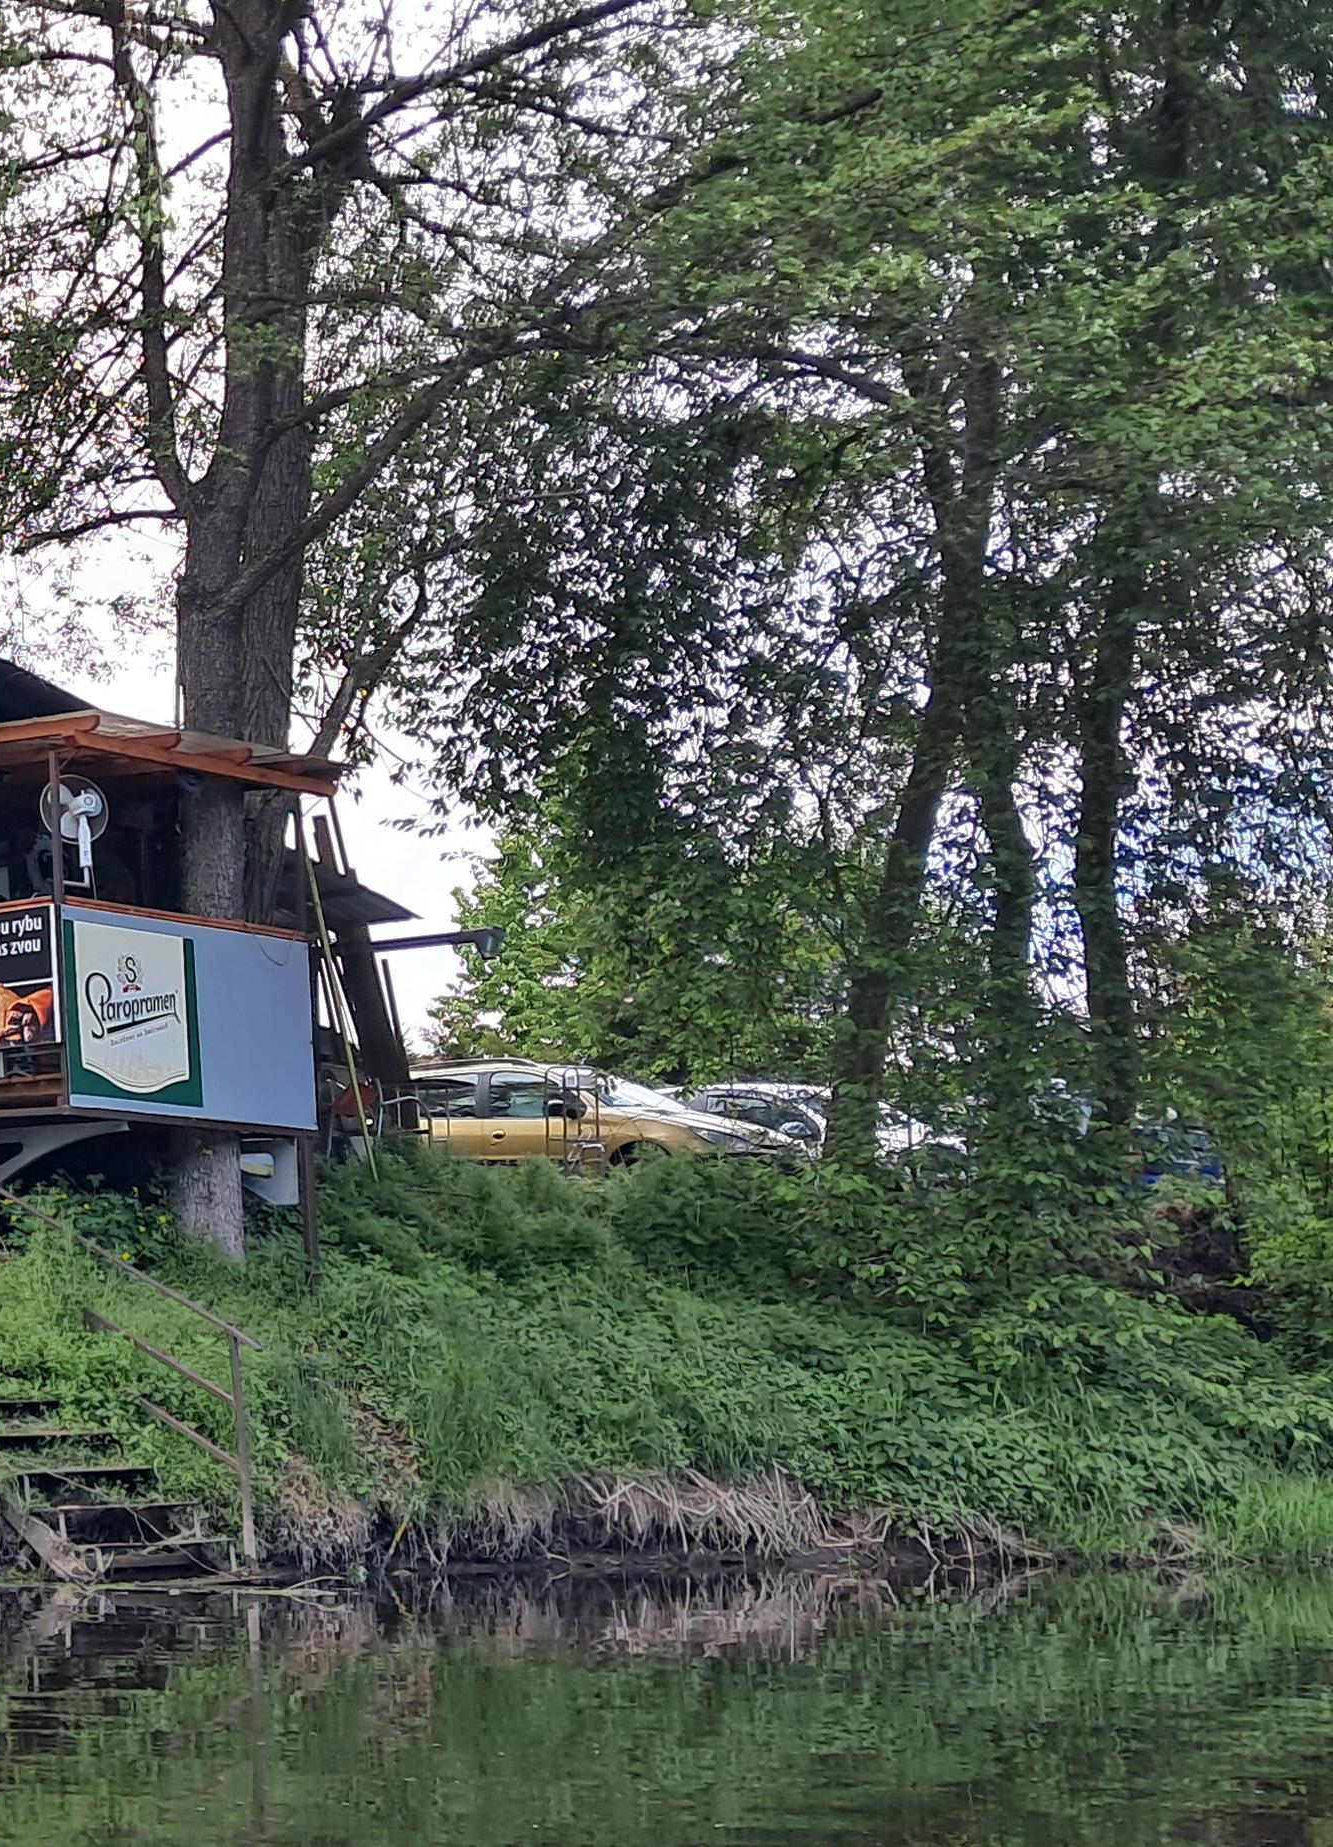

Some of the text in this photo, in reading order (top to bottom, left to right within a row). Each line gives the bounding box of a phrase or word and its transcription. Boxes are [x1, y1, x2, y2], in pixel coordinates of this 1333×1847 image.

[12, 914, 43, 938] rybu
[10, 937, 42, 955] zvou
[85, 971, 181, 1039] Staropramen
